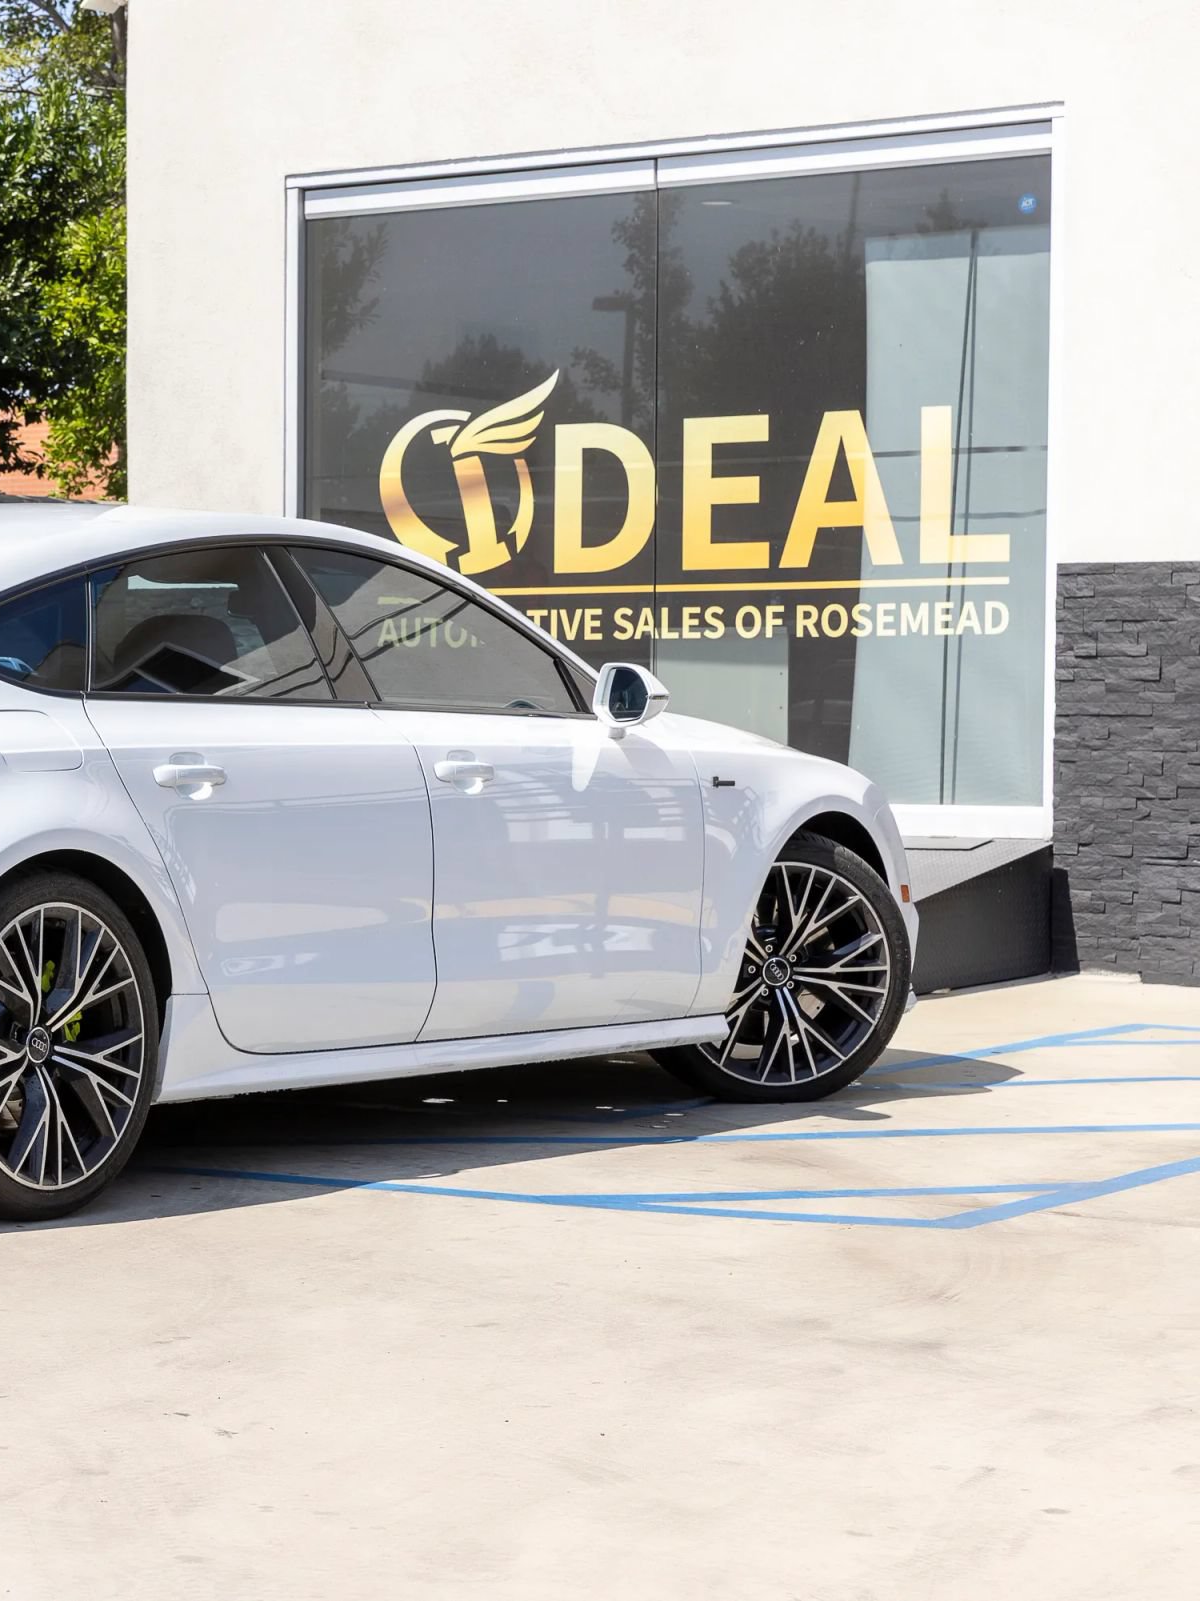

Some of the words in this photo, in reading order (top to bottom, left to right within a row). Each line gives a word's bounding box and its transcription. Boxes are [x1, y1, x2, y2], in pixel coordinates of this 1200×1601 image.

[612, 604, 725, 641] SALES
[734, 604, 785, 639] OF
[795, 600, 1010, 638] ROSEMEAD
